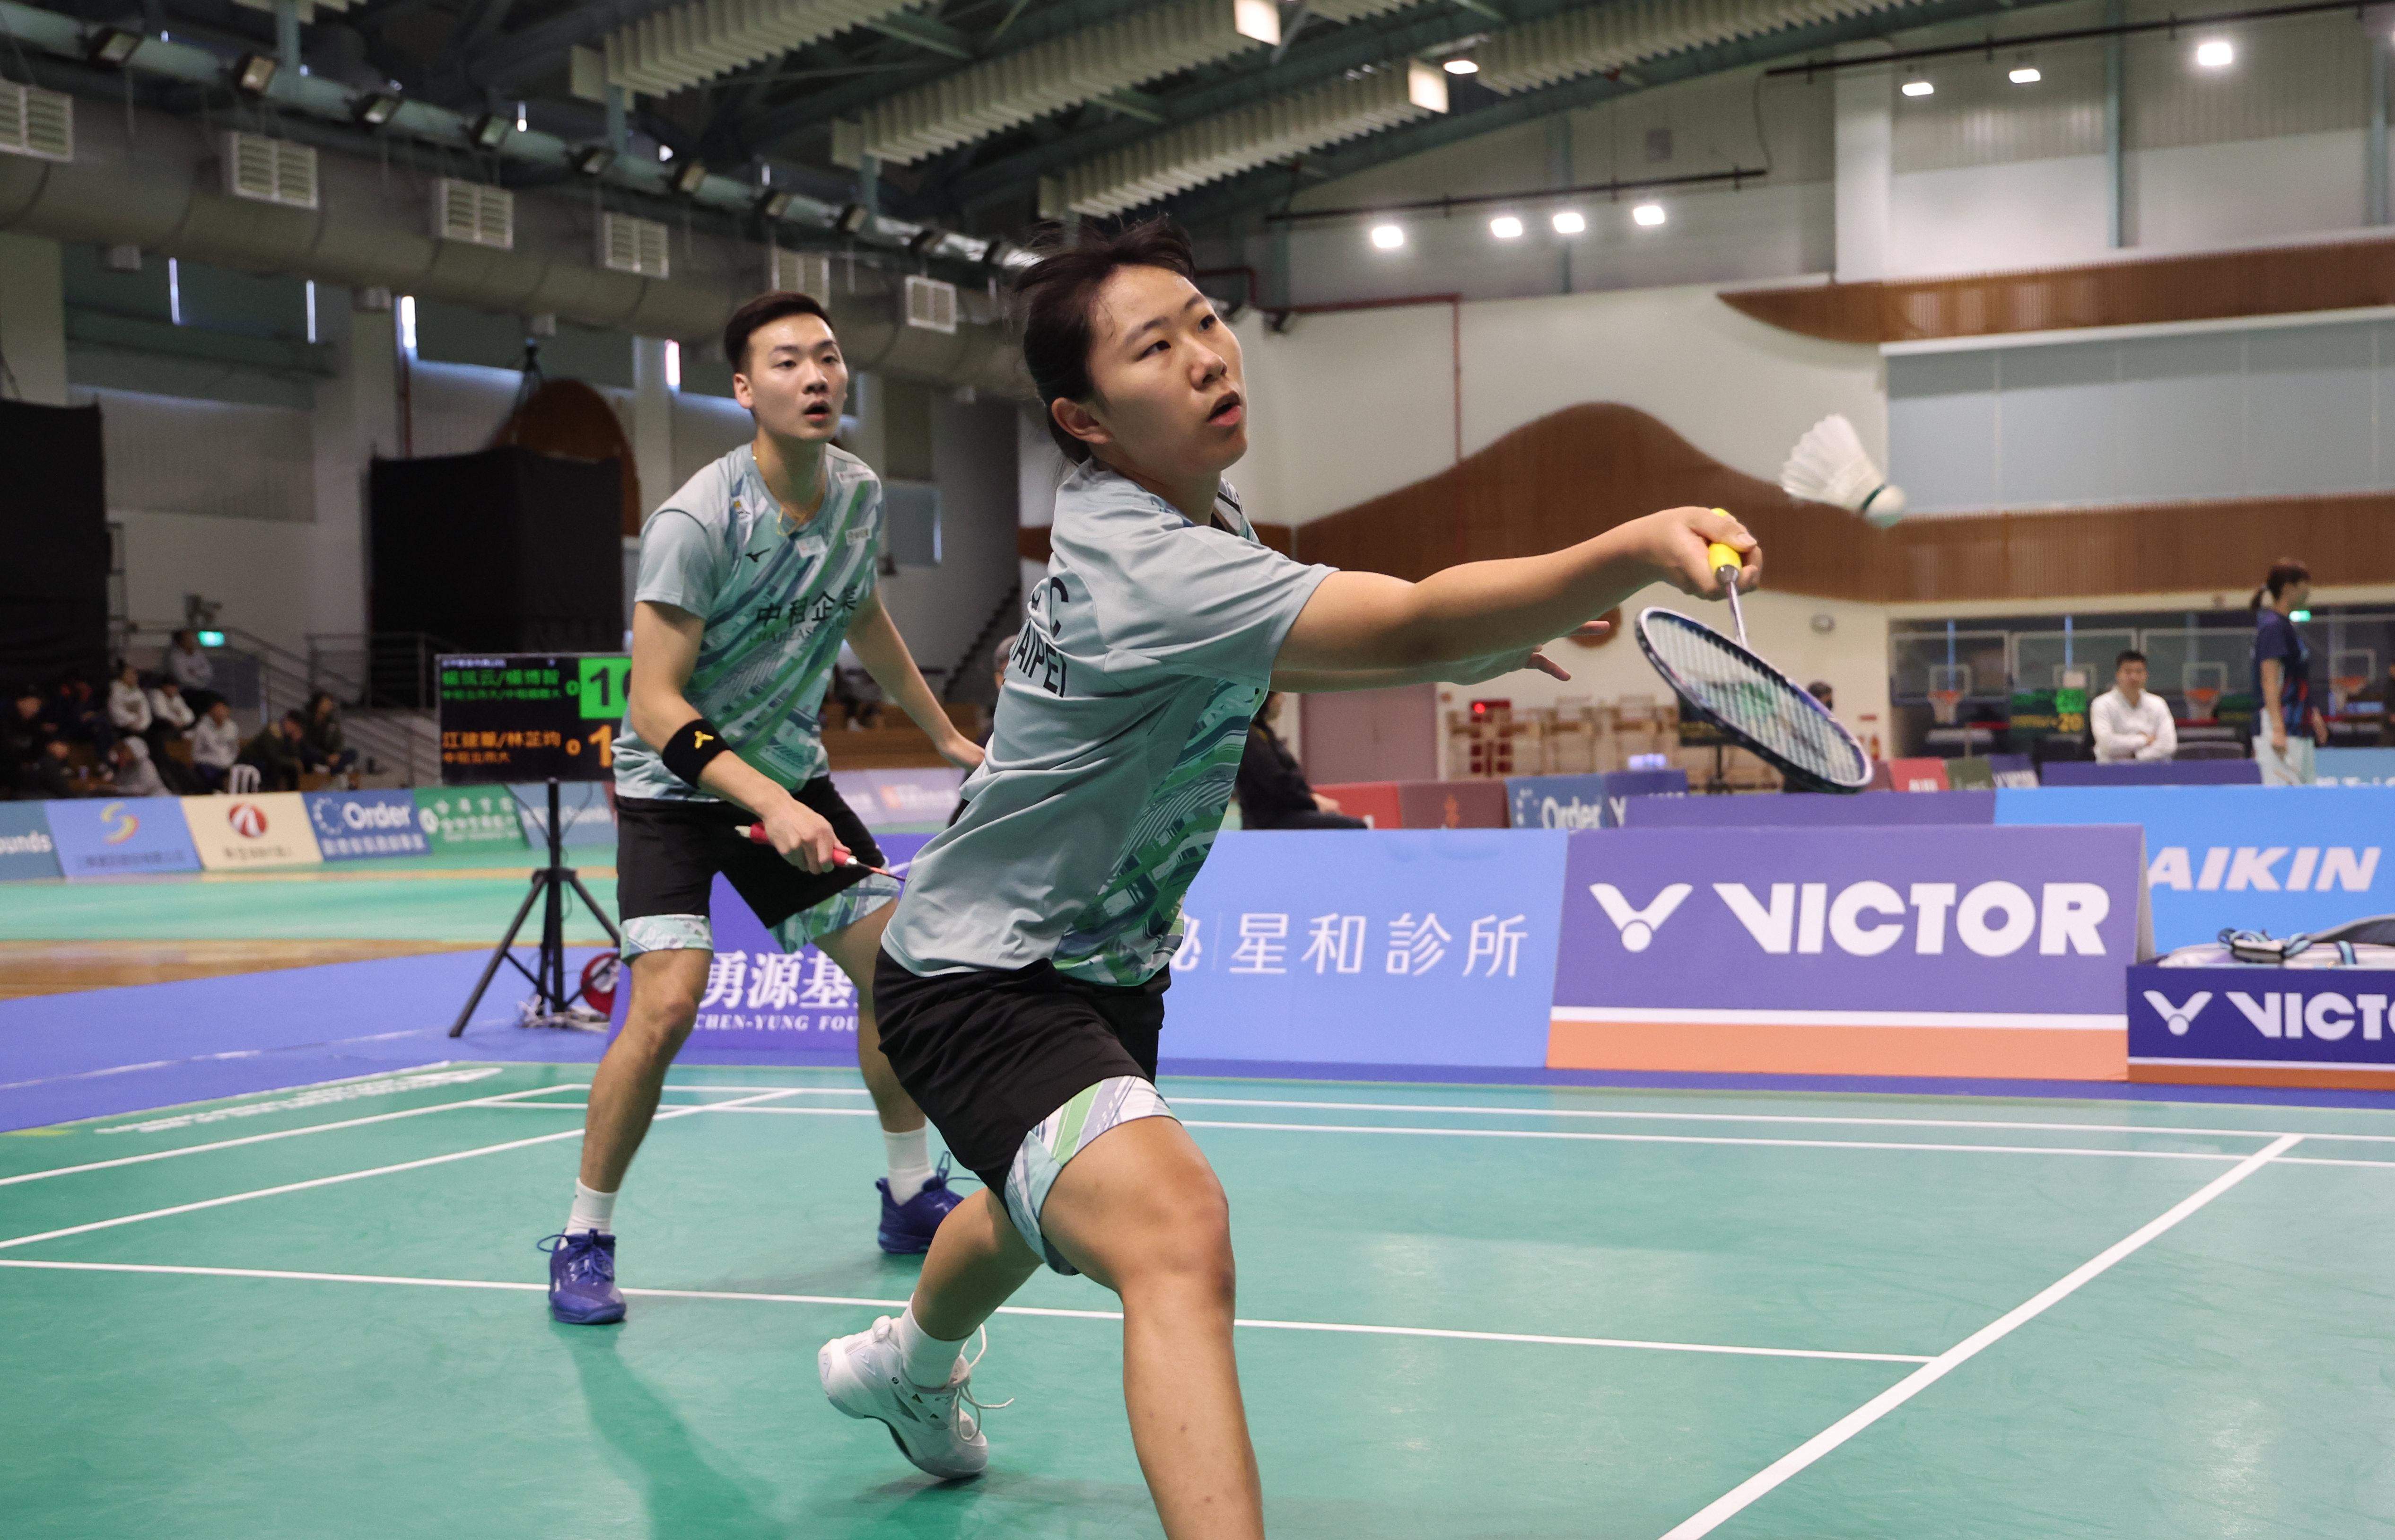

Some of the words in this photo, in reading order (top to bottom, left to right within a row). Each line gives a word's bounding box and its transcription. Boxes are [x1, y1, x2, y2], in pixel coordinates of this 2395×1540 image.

[341, 801, 411, 831] Order
[1229, 912, 1528, 979] 星和診所
[1712, 880, 2110, 957] VICTOR
[698, 949, 858, 1010] 勇源基
[694, 1014, 810, 1031] CHEN-YUNG
[2225, 992, 2395, 1041] VICT
